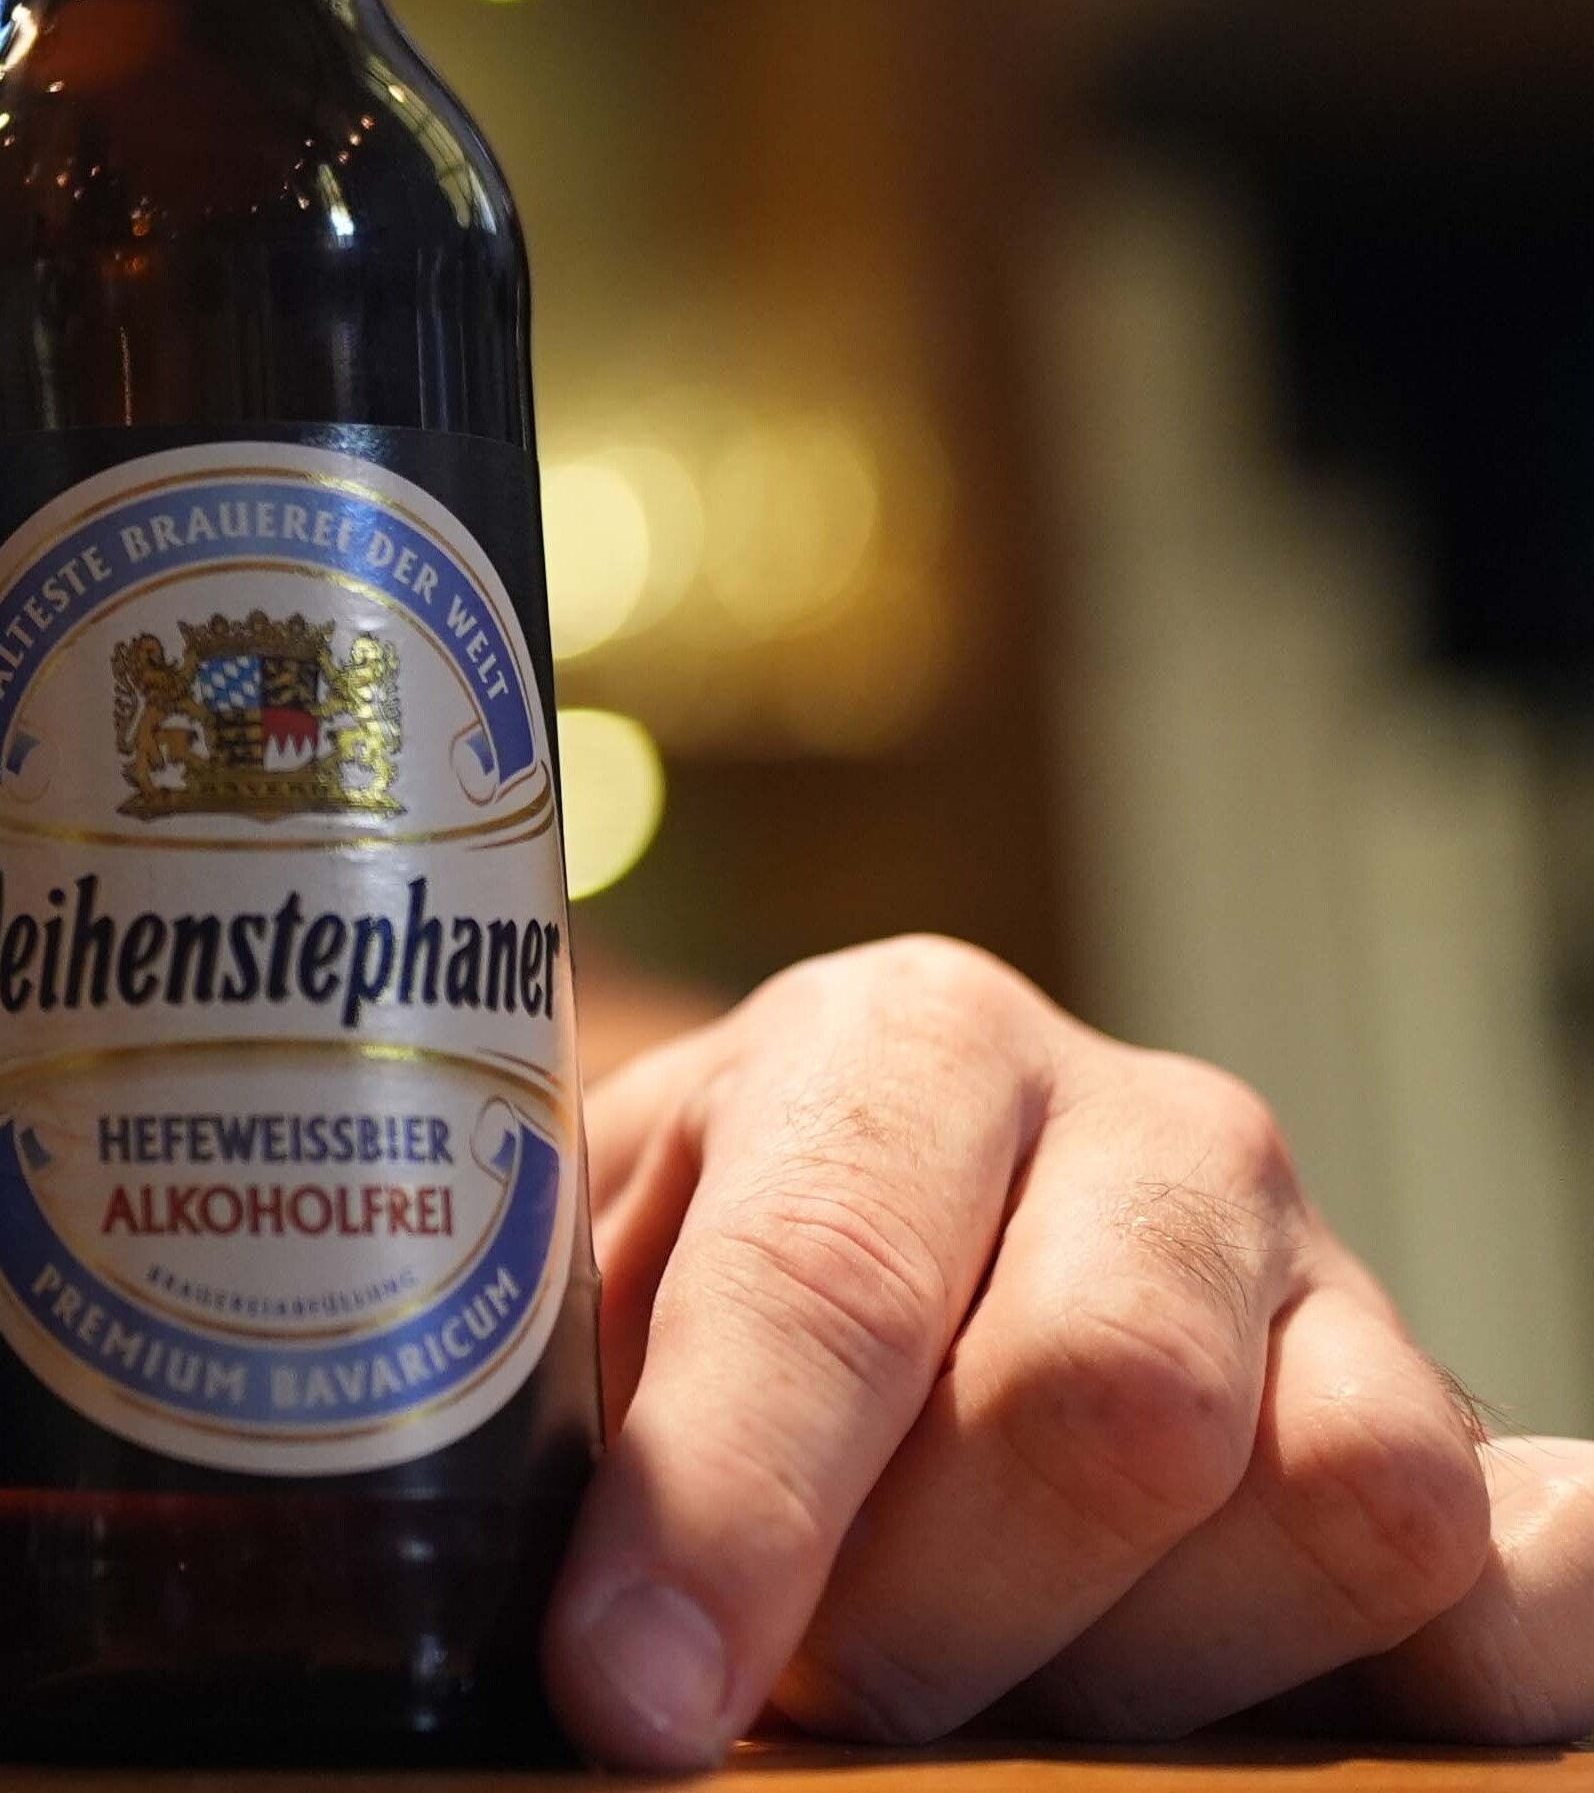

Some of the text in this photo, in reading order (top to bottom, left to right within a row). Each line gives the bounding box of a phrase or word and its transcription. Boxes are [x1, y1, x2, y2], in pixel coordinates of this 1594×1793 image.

[121, 502, 352, 559] BRAUEREI
[367, 532, 441, 605] DER
[444, 593, 510, 701] WELT
[97, 1114, 453, 1164] HEFEWEISSBIER
[101, 1184, 454, 1237] ALKOHOLFREI
[30, 1262, 522, 1407] PREMIUM BAVARICUM
